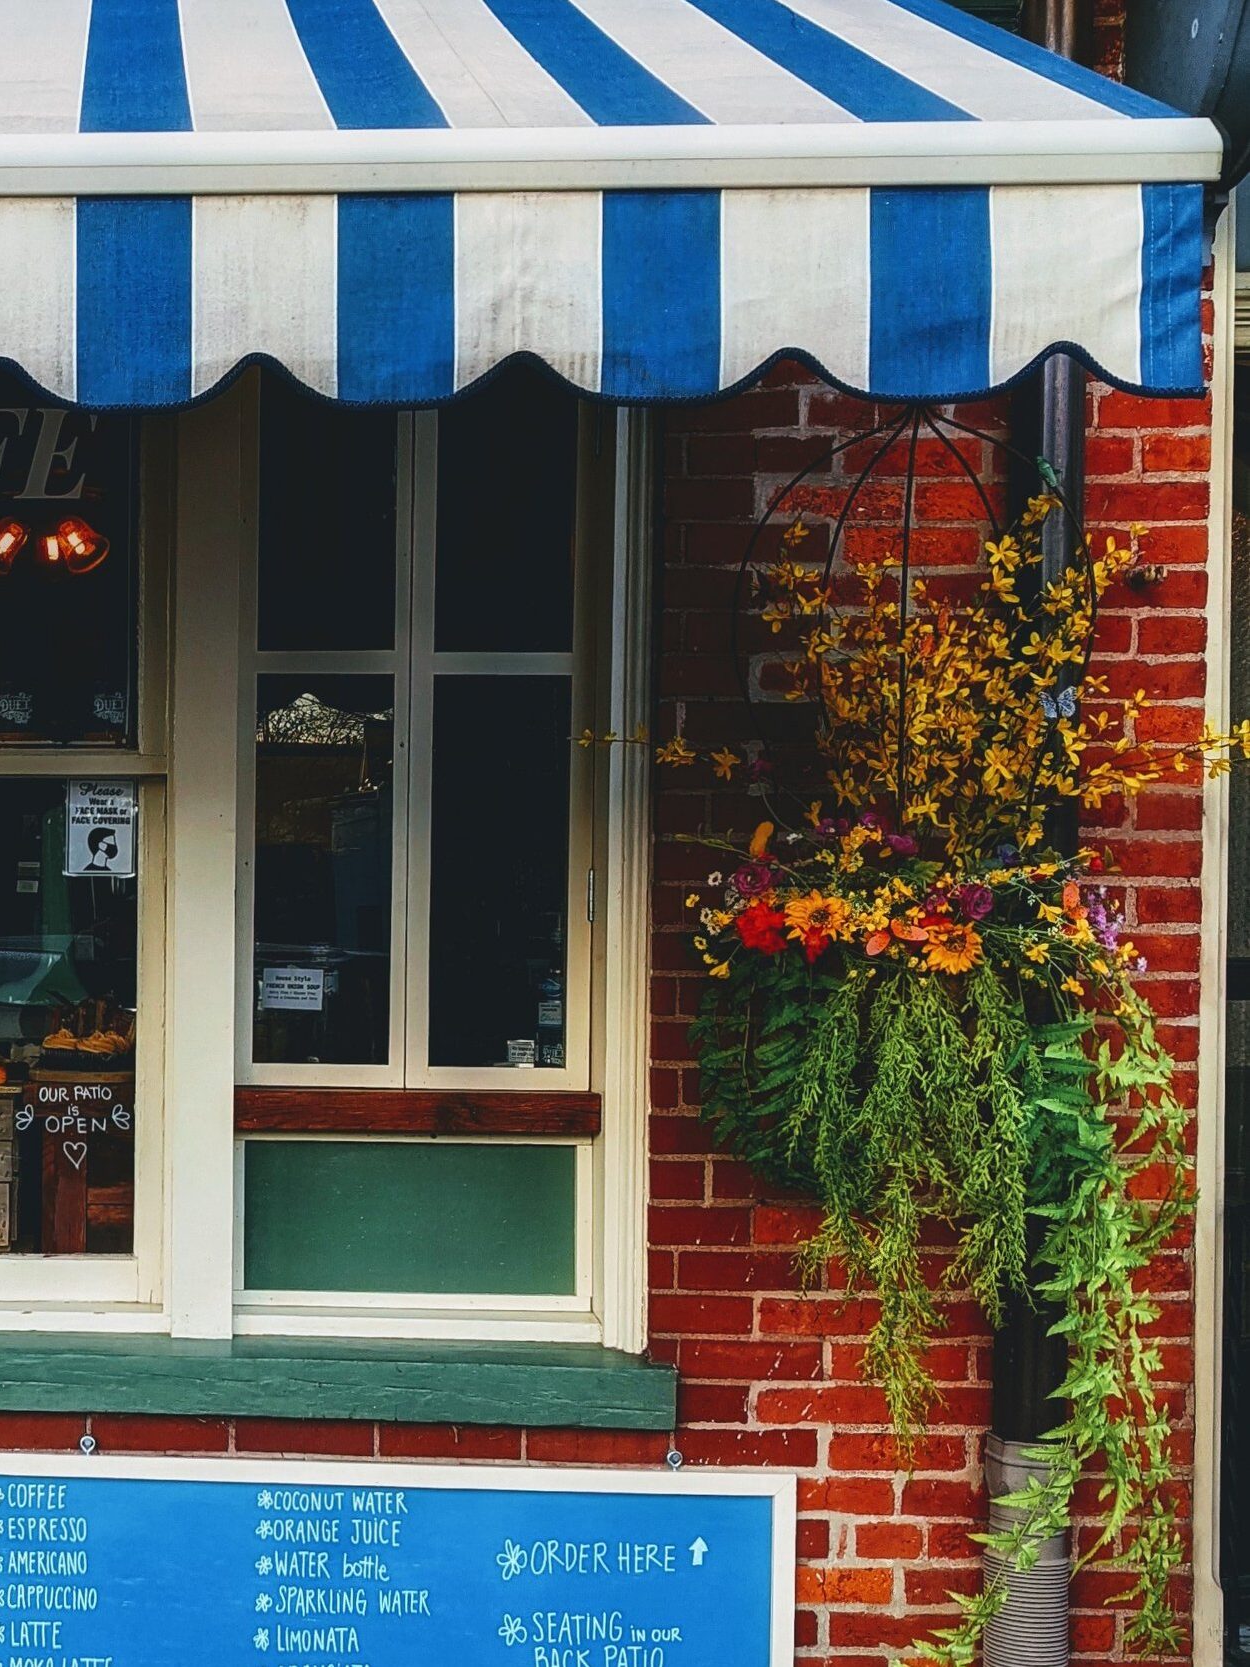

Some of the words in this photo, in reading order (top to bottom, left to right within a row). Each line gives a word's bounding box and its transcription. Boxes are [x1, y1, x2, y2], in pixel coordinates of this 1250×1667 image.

[79, 782, 124, 797] Please
[89, 797, 108, 806] Wear
[71, 816, 91, 825] FACE
[93, 816, 131, 825] COVERING
[75, 806, 94, 815] FACE
[97, 806, 118, 815] MASK
[39, 1087, 69, 1102] OUR
[74, 1084, 112, 1100] PATIO
[45, 1115, 107, 1133] OPEN
[8, 1483, 67, 1510] COFFEE
[273, 1491, 344, 1512] COCONUT
[352, 1491, 409, 1515] WATER
[8, 1517, 87, 1543] ESPRESSO
[273, 1519, 340, 1545] ORANGE
[351, 1517, 402, 1547] JUICE
[8, 1550, 88, 1576] AMERICANO
[275, 1550, 331, 1579] WATER
[343, 1552, 390, 1582] bottle
[530, 1541, 612, 1575] ORDER
[618, 1542, 676, 1575] HERE
[7, 1584, 98, 1611] CAPPUCCINO
[275, 1585, 368, 1617] SPARKLING
[379, 1589, 431, 1616] WATER
[11, 1620, 62, 1650] LATTE
[277, 1624, 360, 1654] LIMONATA
[532, 1610, 623, 1645] SEATING
[651, 1626, 683, 1642] OUR
[534, 1646, 590, 1667] BACK
[604, 1645, 665, 1667] PATIO
